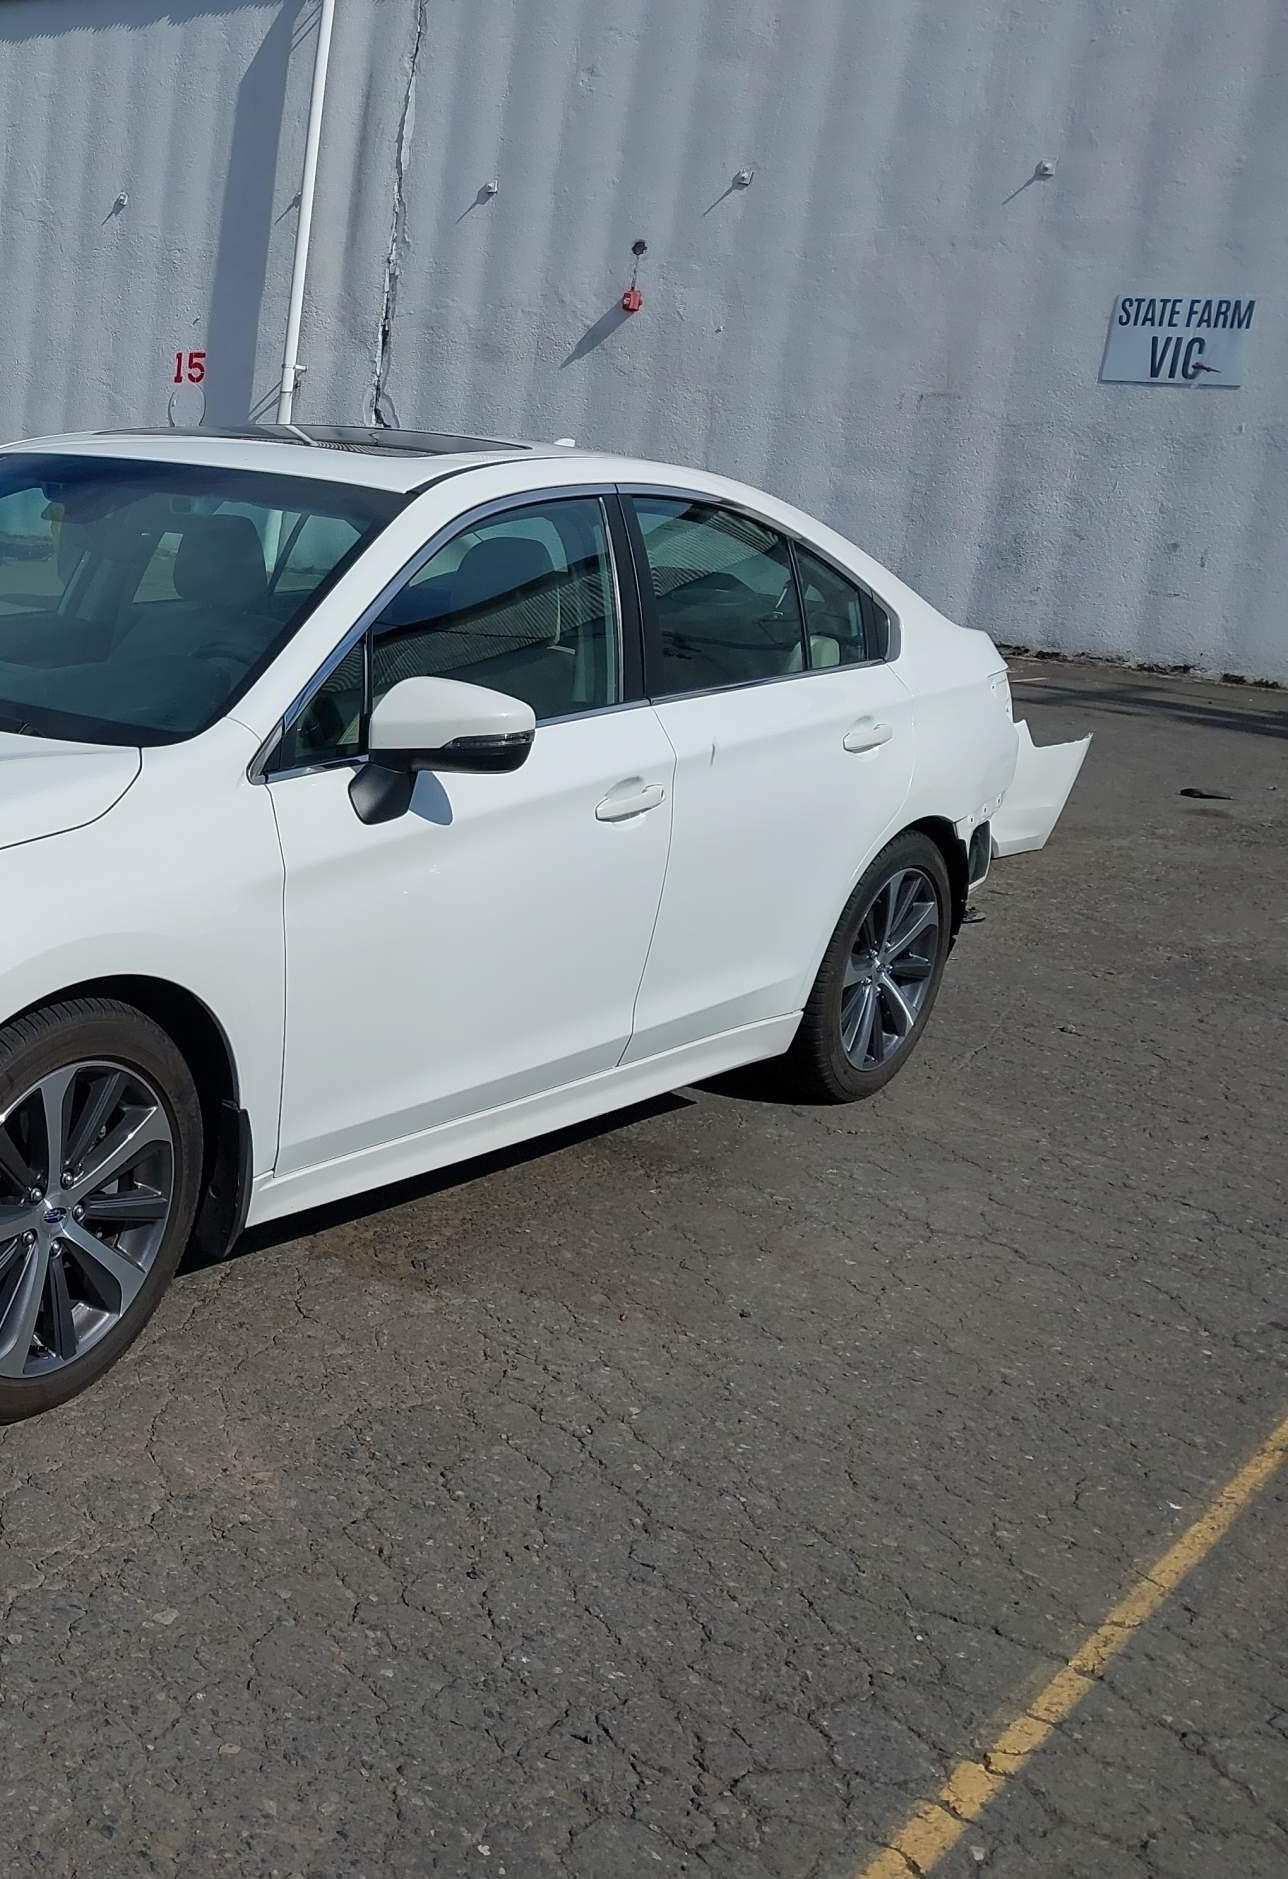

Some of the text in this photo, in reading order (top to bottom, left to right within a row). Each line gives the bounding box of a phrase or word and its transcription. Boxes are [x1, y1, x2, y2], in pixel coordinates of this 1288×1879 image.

[1118, 297, 1256, 329] STATE FARM
[173, 351, 206, 384] 15
[1149, 336, 1206, 380] VIC
